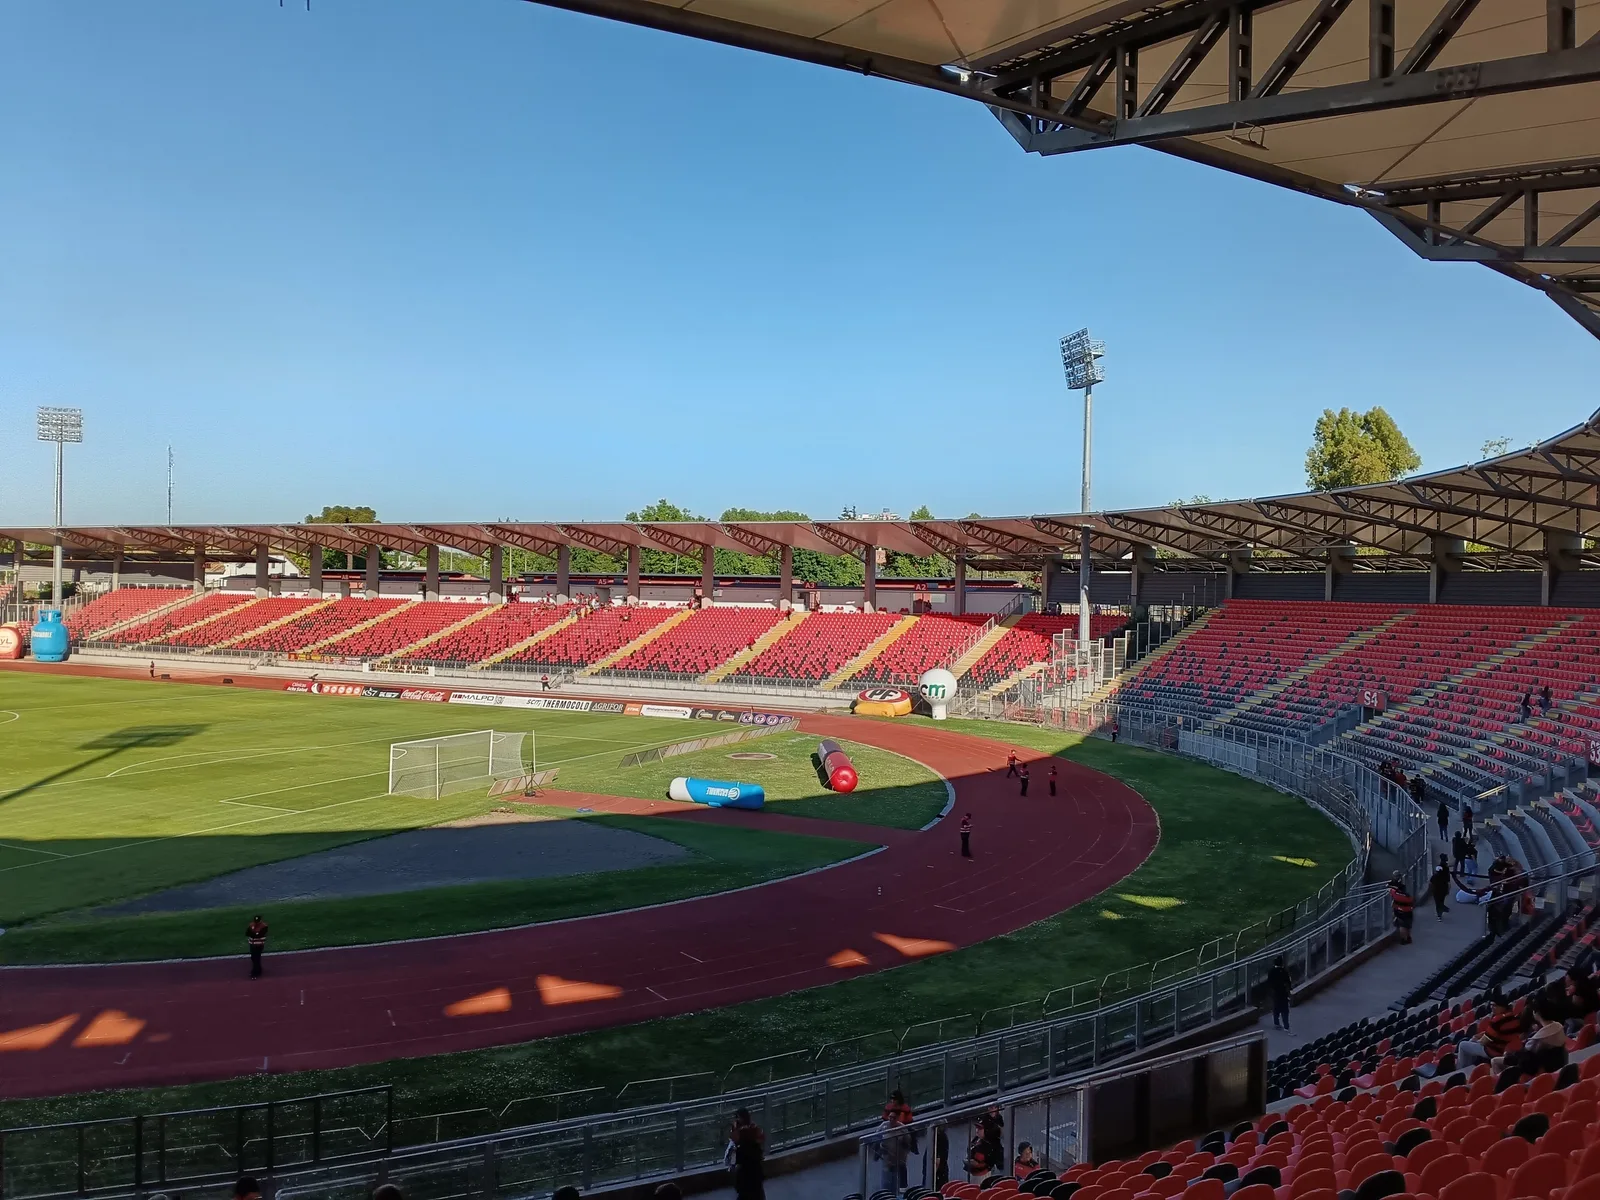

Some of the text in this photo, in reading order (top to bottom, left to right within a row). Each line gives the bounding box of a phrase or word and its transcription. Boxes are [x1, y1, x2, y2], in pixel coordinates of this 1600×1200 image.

[461, 693, 495, 702] MALPO
[868, 688, 898, 700] PF
[1363, 690, 1378, 707] S4
[542, 699, 590, 710] THERMOCOLD
[592, 702, 624, 711] AGRIFOR
